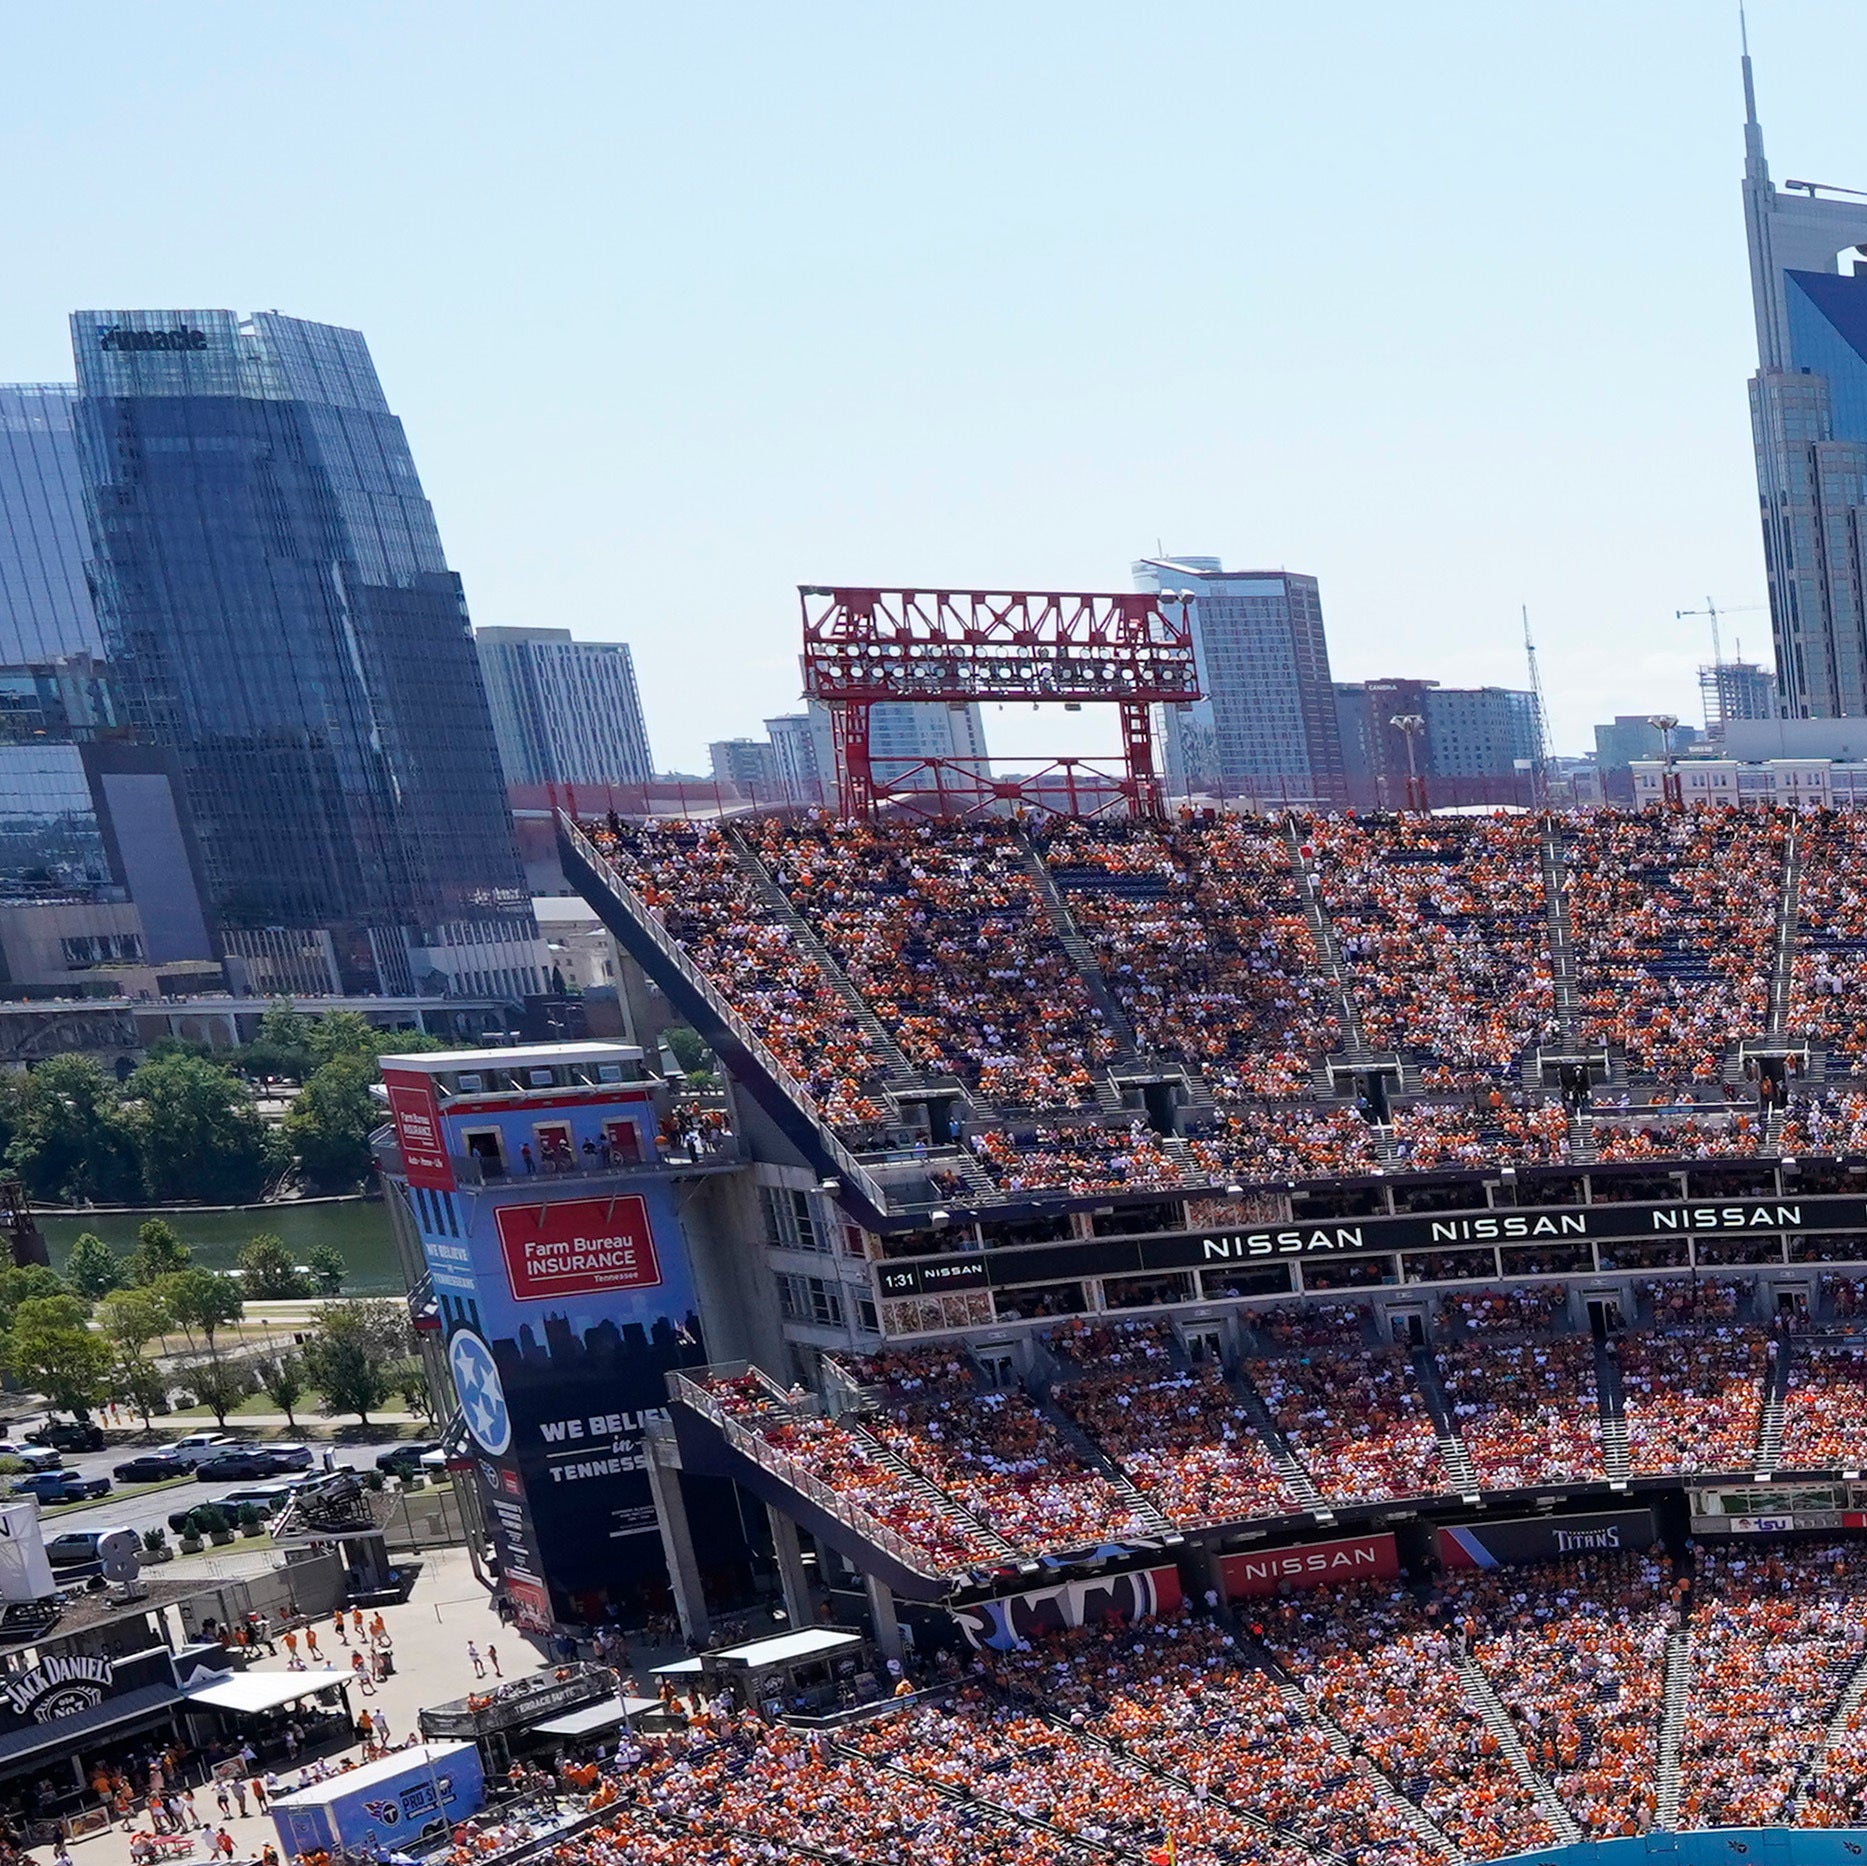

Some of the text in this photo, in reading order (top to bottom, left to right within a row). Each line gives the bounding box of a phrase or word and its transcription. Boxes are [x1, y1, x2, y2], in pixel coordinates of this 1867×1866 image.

[96, 324, 208, 351] Pinnacle
[1431, 1214, 1586, 1240] NISSAN
[1652, 1206, 1801, 1229] NISSAN
[525, 1232, 634, 1259] Farm Bureau
[1203, 1228, 1363, 1259] NISSAN
[526, 1247, 637, 1278] INSURANCE
[885, 1263, 983, 1288] 1:31 NISSAN
[593, 1270, 640, 1284] Tennessee
[540, 1407, 668, 1444] WE BELIE
[548, 1457, 648, 1482] TENNESS
[1553, 1526, 1620, 1552] TITANS
[1245, 1547, 1375, 1581] NISSAN
[5, 1655, 114, 1716] JACK DANIEL'S
